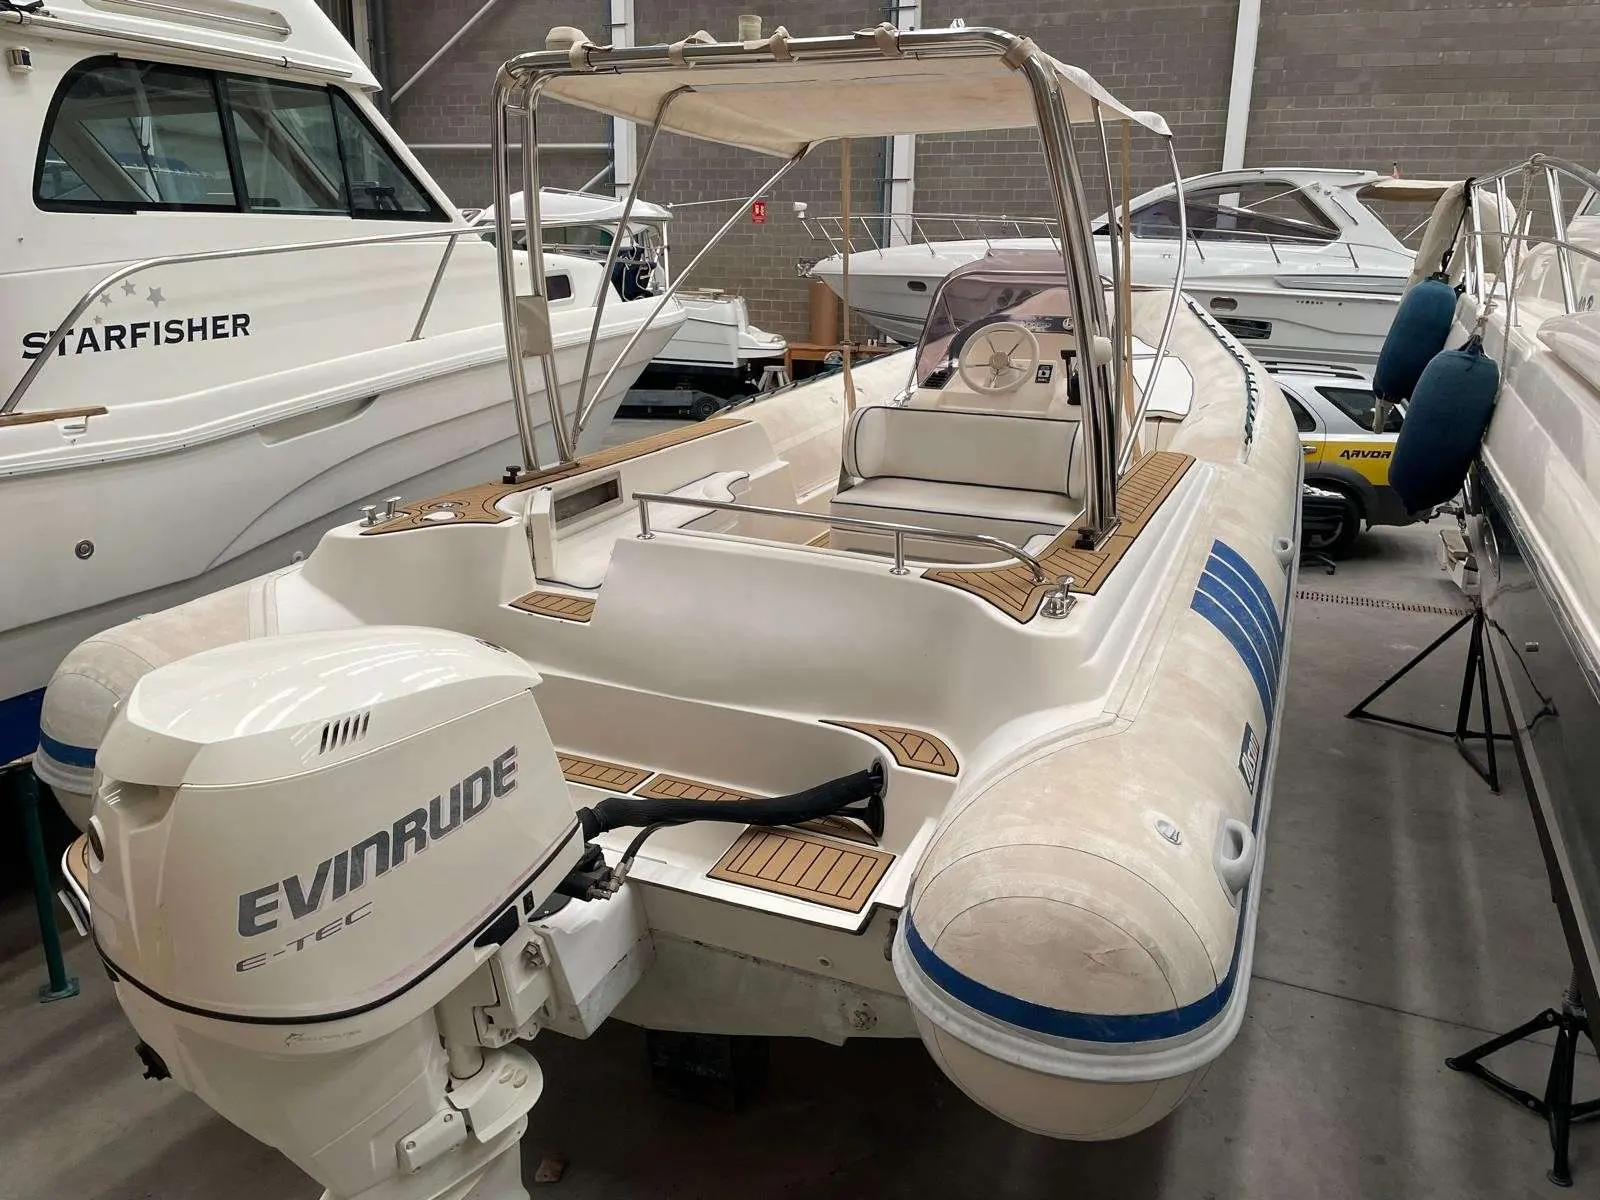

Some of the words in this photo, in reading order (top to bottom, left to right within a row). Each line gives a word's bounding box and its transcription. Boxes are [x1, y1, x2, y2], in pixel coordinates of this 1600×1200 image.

[21, 313, 250, 359] STARFISHER
[1339, 449, 1392, 460] ARVOR
[237, 745, 518, 938] EVINRUDE
[235, 901, 373, 973] E-TEC
